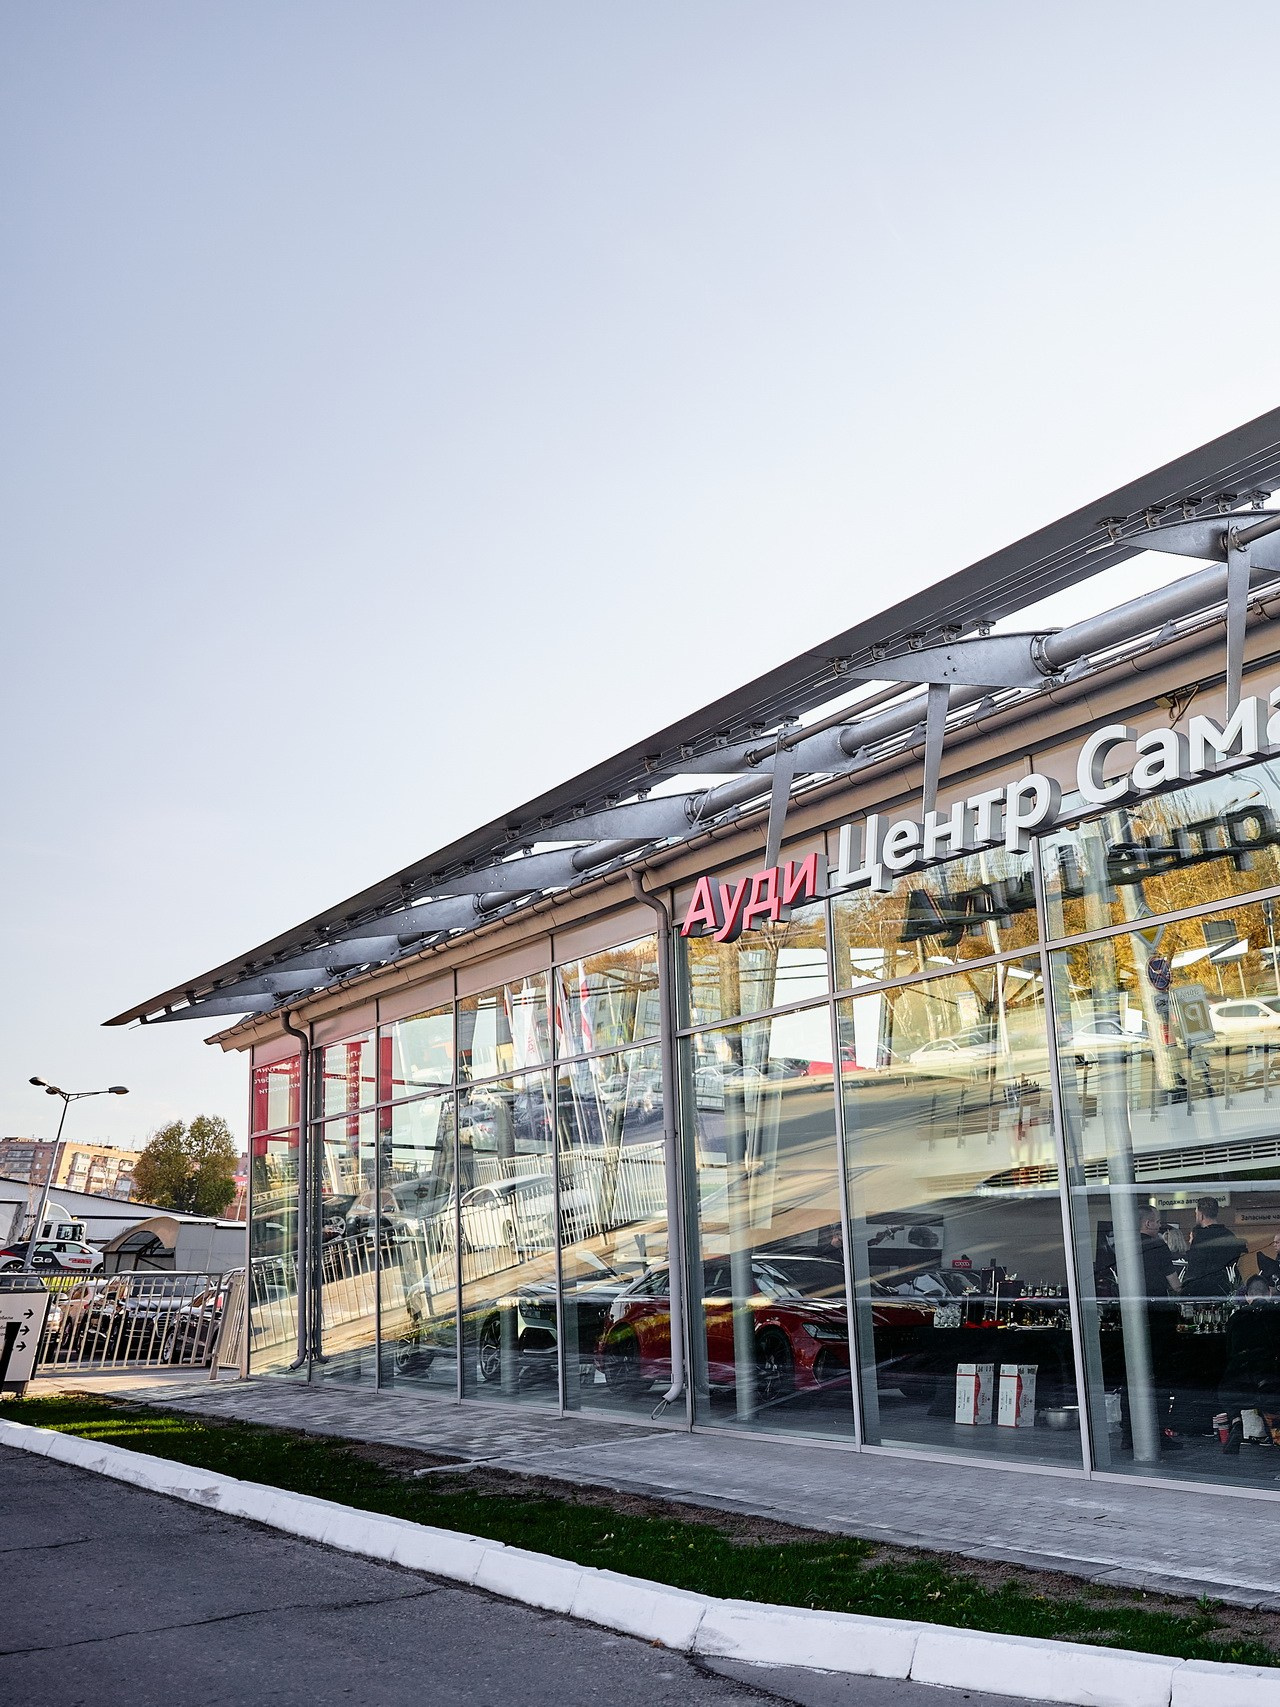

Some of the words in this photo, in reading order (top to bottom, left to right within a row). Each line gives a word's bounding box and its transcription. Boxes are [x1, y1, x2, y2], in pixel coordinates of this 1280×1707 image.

[681, 852, 827, 943] Ауди
[836, 771, 1062, 893] Центр
[1241, 1213, 1271, 1222] Запасные
